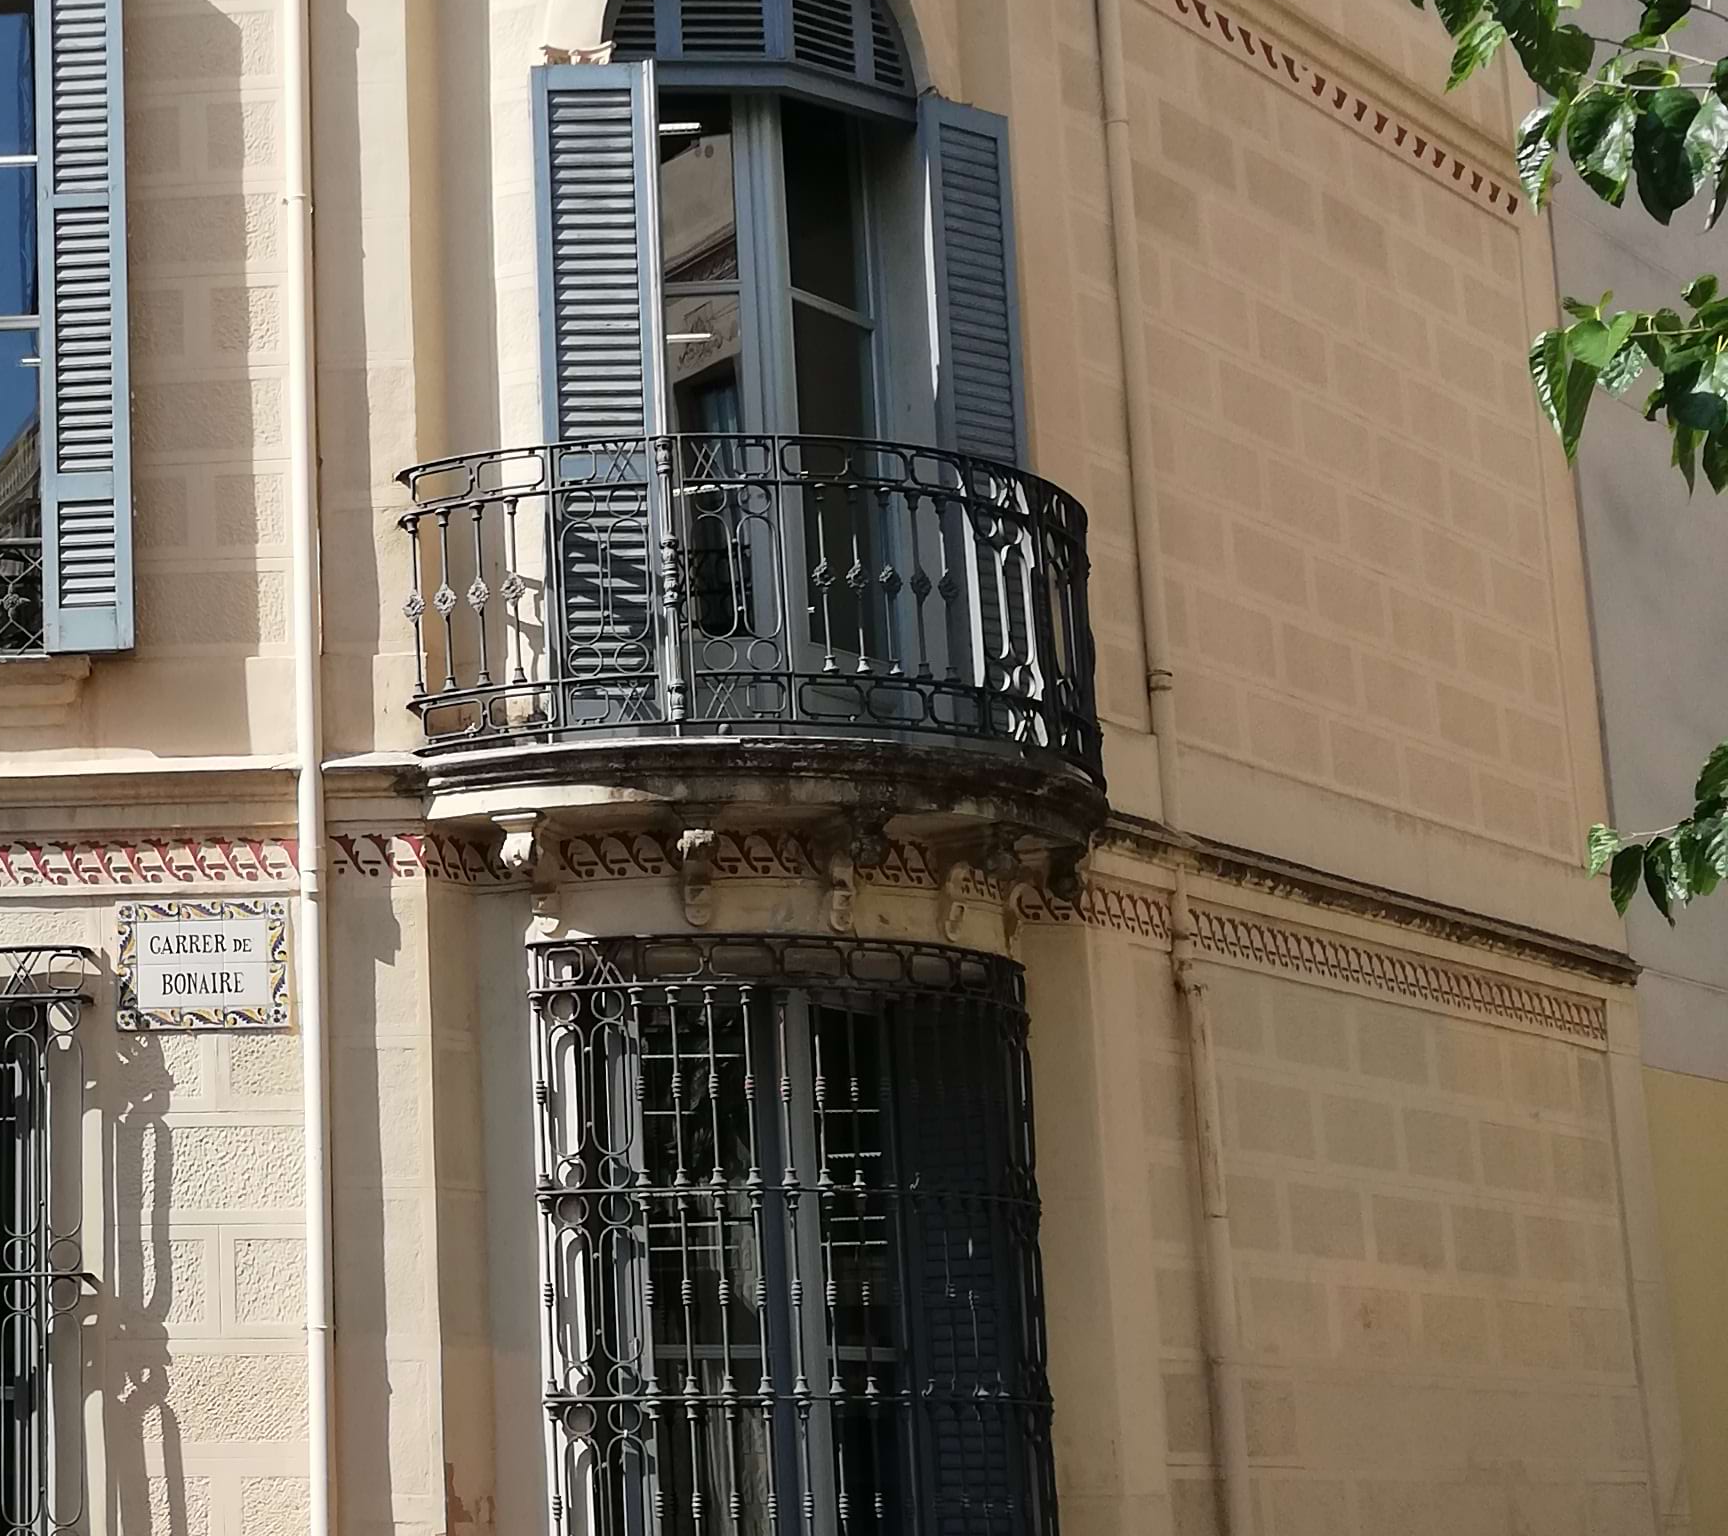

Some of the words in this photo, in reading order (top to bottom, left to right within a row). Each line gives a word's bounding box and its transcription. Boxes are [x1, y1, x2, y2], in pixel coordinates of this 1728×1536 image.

[149, 934, 227, 955] CARRER
[232, 938, 253, 953] DE
[161, 972, 245, 995] BONAIRE
